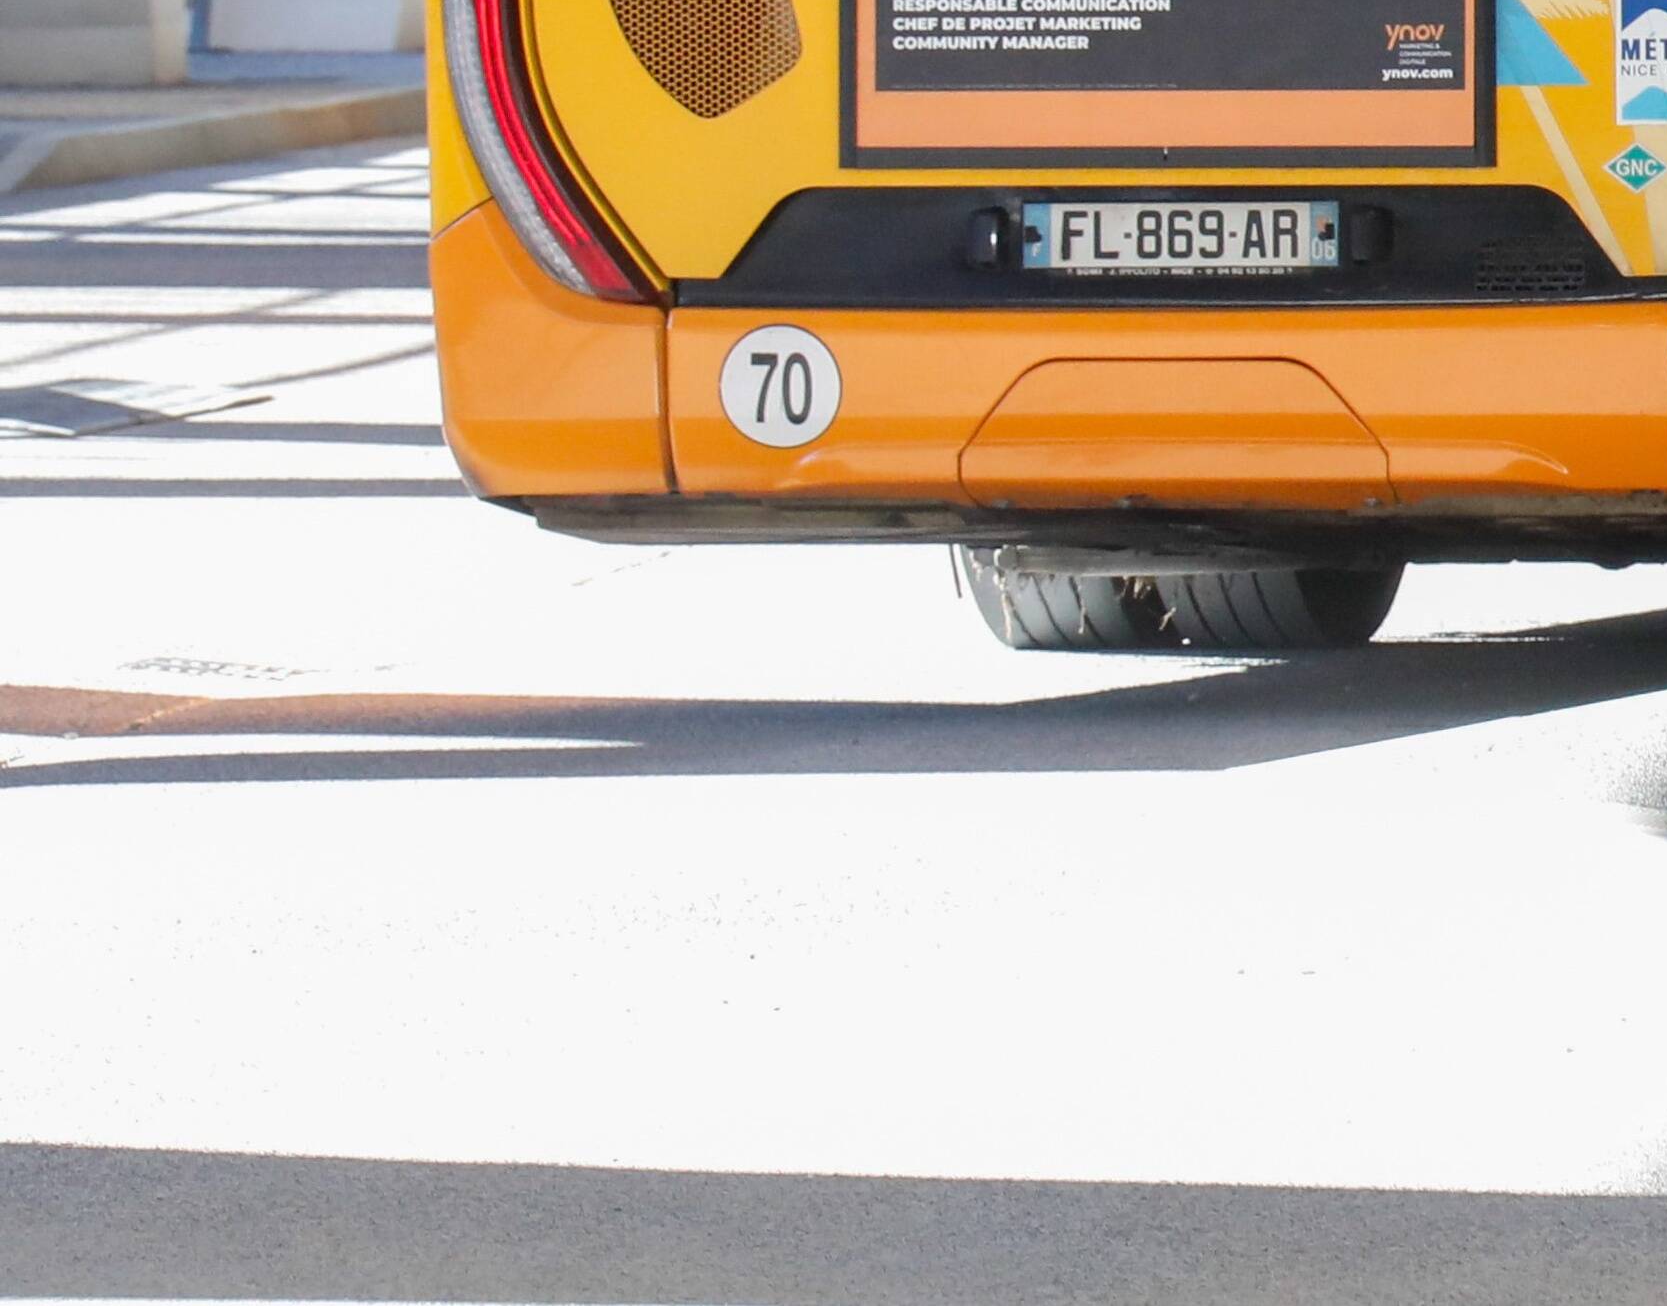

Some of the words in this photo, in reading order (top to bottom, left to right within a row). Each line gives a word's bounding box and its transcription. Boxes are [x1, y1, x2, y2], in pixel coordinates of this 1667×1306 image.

[892, 16, 938, 32] CHEF
[942, 16, 966, 31] DE
[970, 16, 1036, 31] PROJET
[1040, 16, 1142, 31] MARKETING
[892, 35, 999, 50] COMMUNITY
[1001, 34, 1090, 50] MANAGER
[1384, 24, 1445, 51] ynov
[1382, 69, 1454, 81] ynov.com
[1621, 65, 1658, 76] NICE
[1616, 158, 1659, 177] GNC
[1061, 209, 1299, 260] FL-869-AR
[1312, 241, 1335, 259] 06
